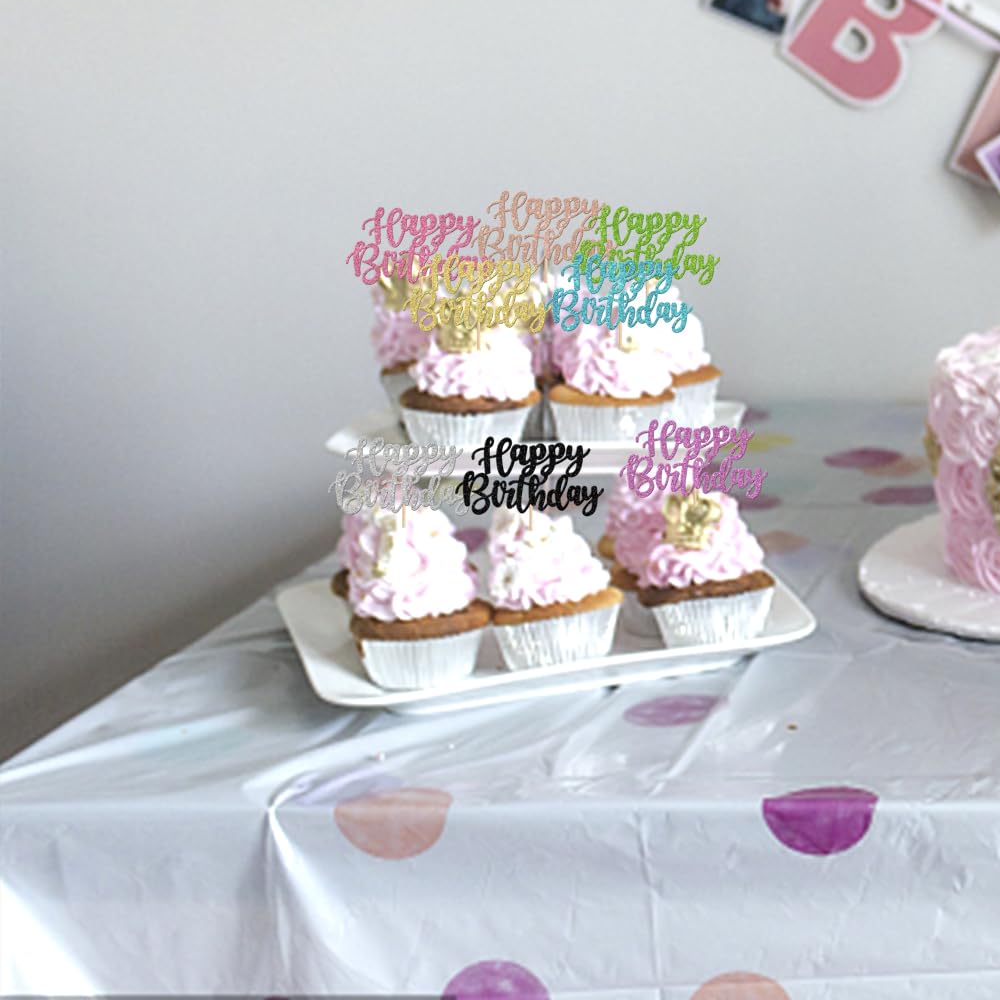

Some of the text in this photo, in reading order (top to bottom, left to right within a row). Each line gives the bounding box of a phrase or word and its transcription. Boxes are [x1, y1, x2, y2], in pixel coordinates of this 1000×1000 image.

[362, 206, 481, 253] Happy
[486, 190, 607, 238] Happy
[587, 204, 708, 254] Happy
[420, 253, 540, 300] Happy
[561, 252, 680, 300] Happy
[403, 288, 552, 334] Birthday
[545, 287, 694, 334] Birthday
[344, 438, 464, 484] Happy
[471, 436, 591, 483] Happy
[635, 419, 755, 466] Happy
[454, 470, 605, 517] Birthday
[619, 454, 769, 500] Birthday
